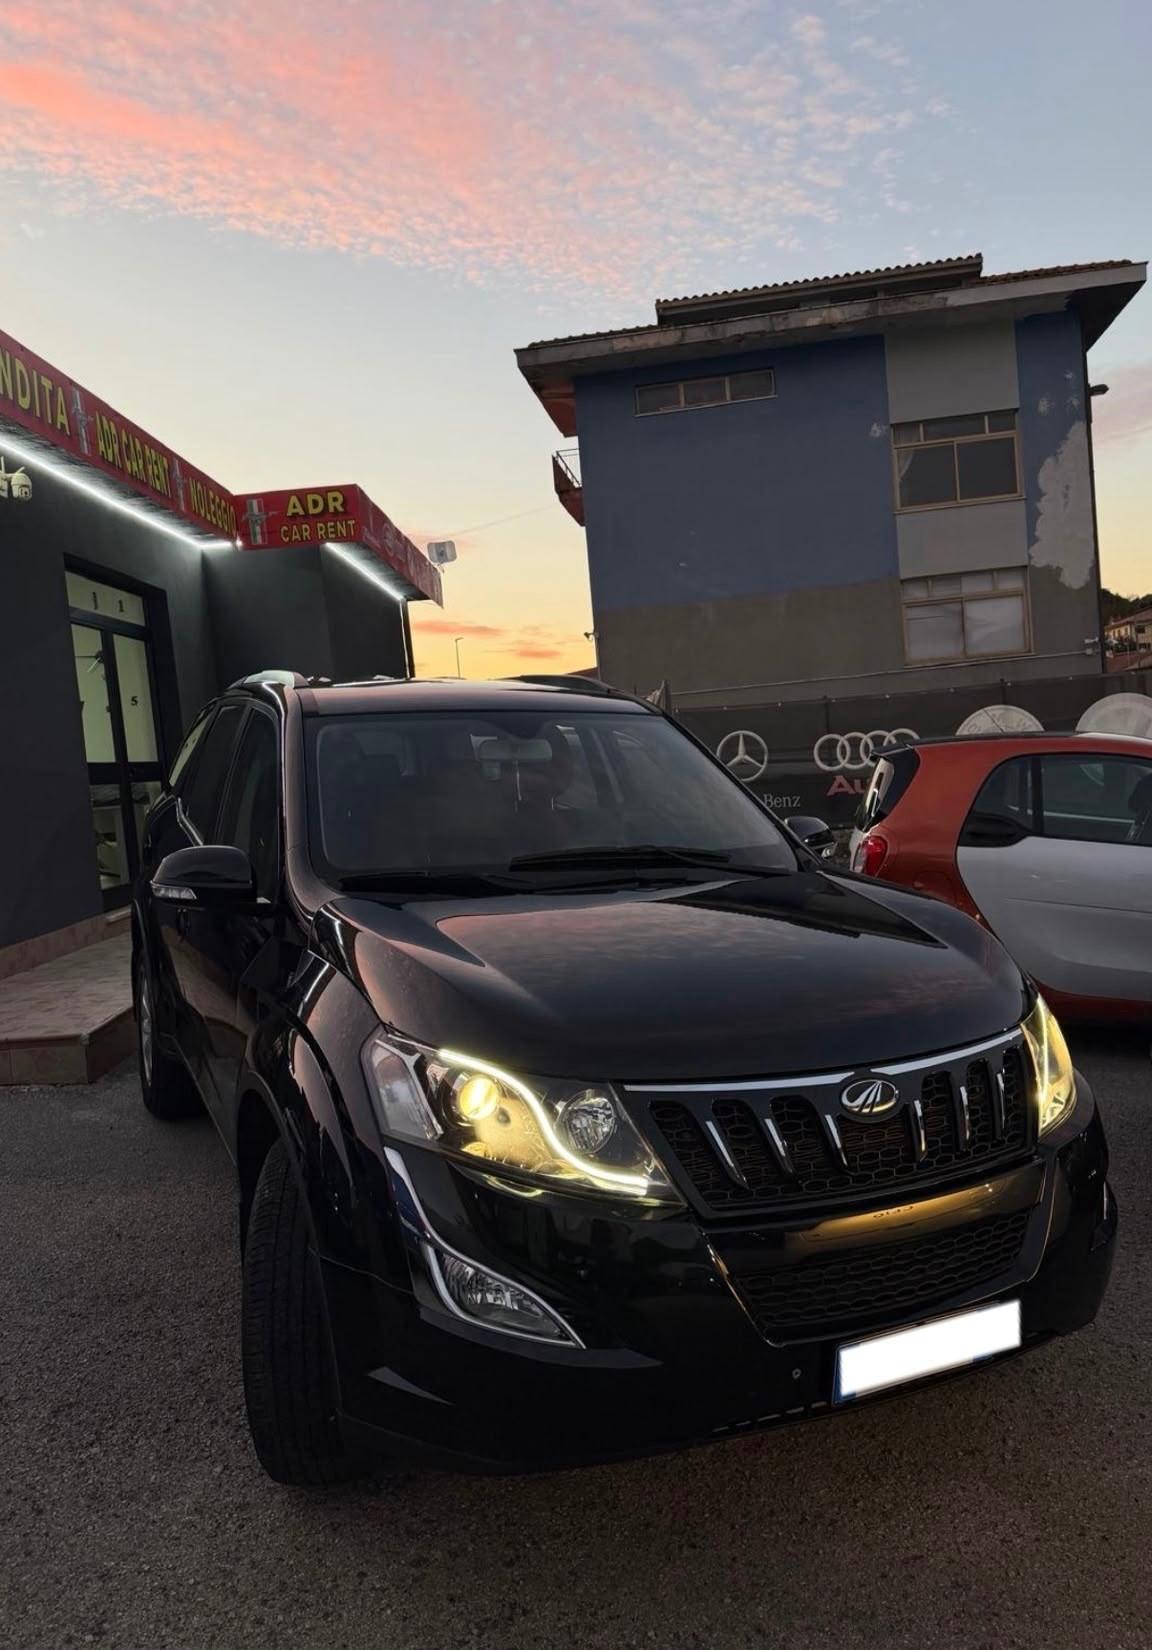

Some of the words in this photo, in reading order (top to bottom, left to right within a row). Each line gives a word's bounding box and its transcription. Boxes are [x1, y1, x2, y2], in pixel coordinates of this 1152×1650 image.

[0, 347, 70, 436] NDITA
[96, 410, 122, 469] ADR
[121, 428, 147, 483] CAR
[144, 444, 171, 498] RENT
[190, 477, 237, 538] NOLEGGIO
[286, 490, 345, 517] ADR
[280, 525, 311, 543] CAR
[317, 520, 355, 540] RENT
[763, 793, 801, 808] Benz
